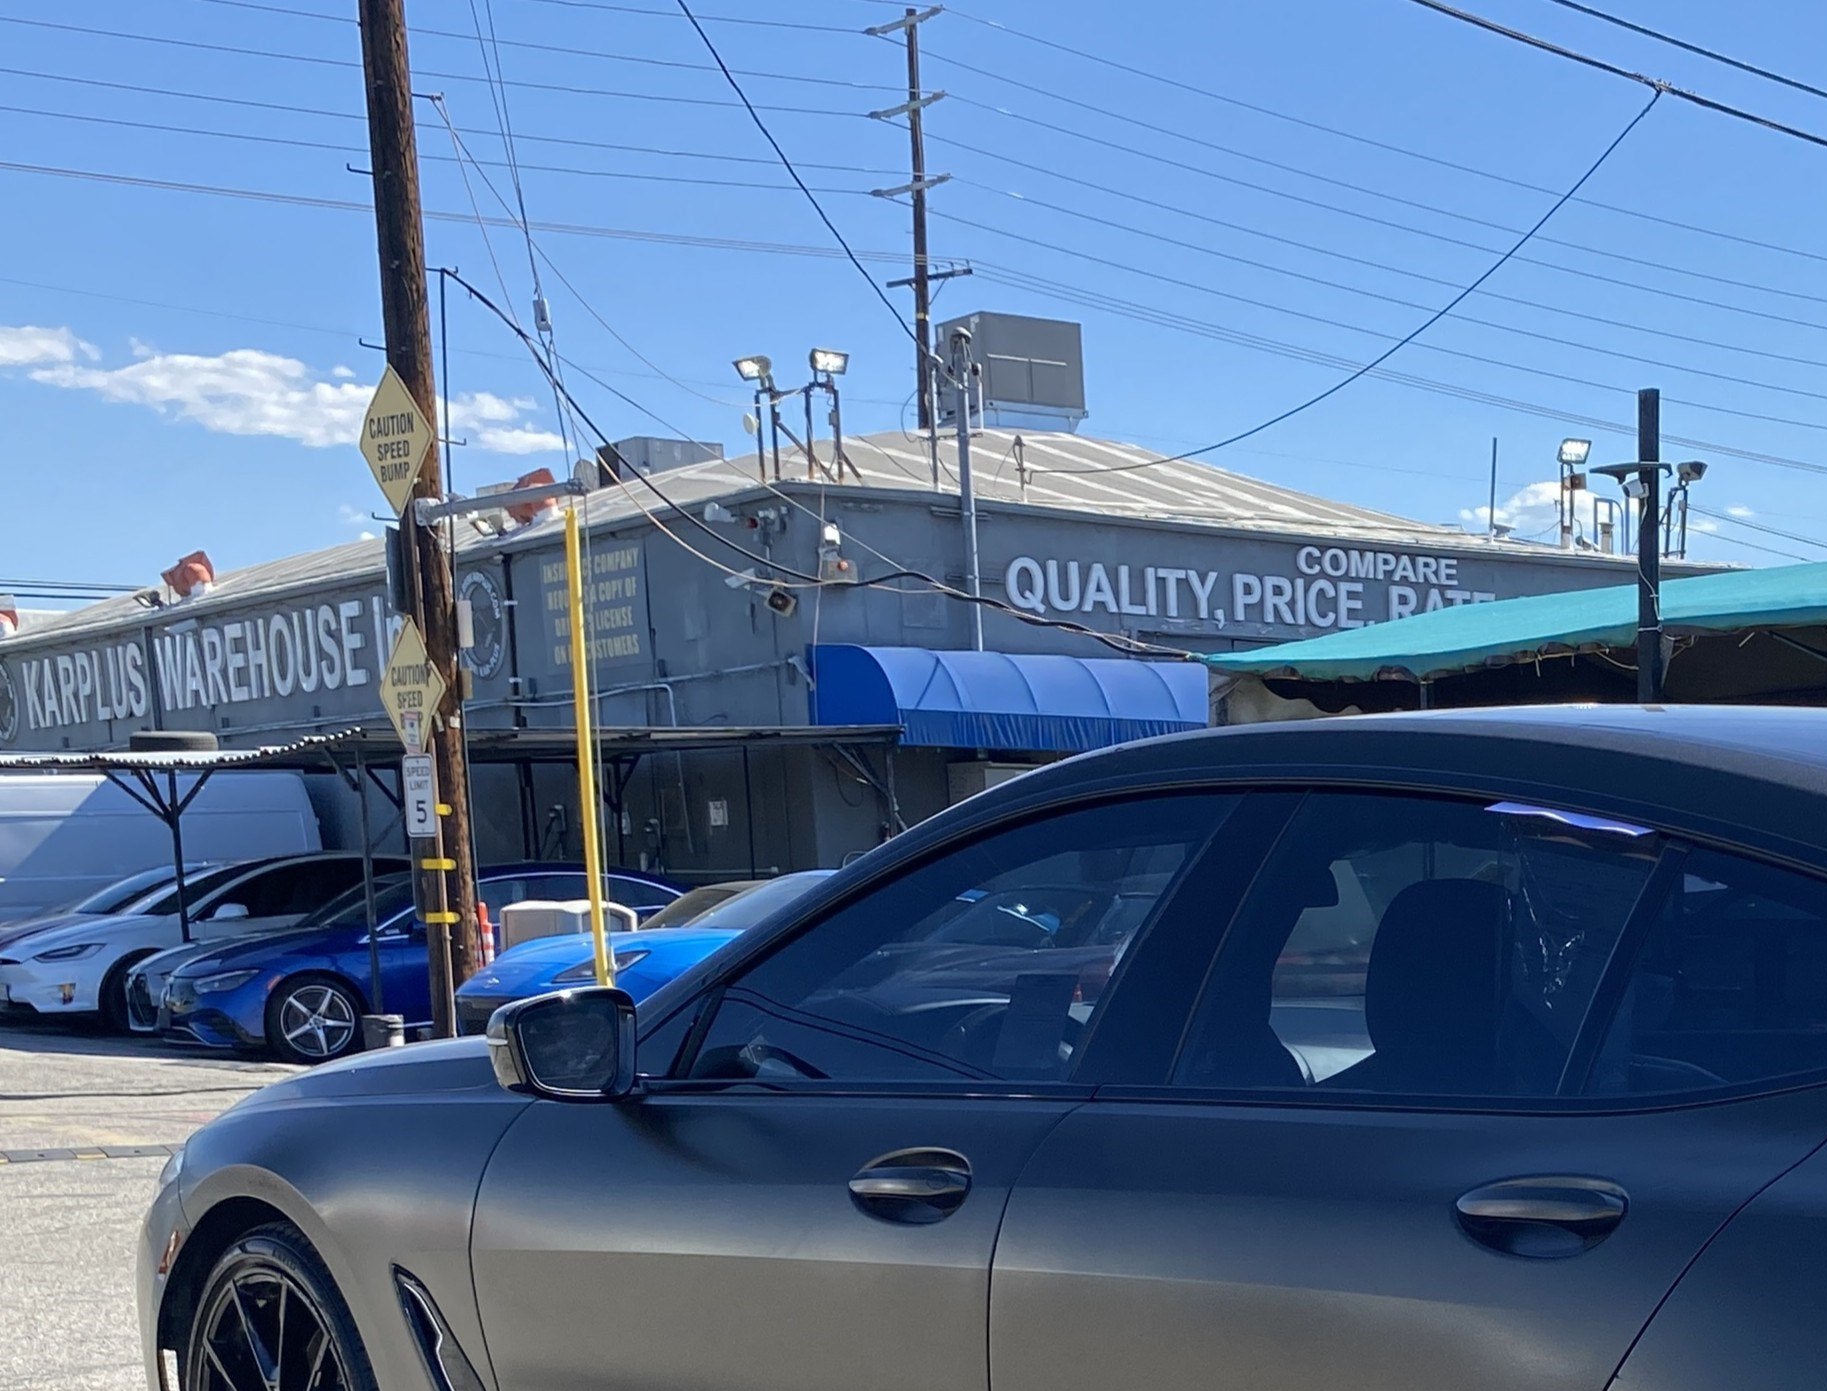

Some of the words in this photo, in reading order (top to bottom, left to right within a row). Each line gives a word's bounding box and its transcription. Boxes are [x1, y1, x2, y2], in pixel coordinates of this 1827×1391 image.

[368, 411, 414, 439] CAUTION
[377, 440, 410, 461] SPEED
[380, 462, 410, 482] BUMP
[594, 547, 639, 574] COMPANY
[1296, 546, 1459, 586] COMPARE
[599, 579, 623, 602] COPY
[625, 576, 636, 597] OF
[1005, 556, 1225, 629] QUALITY,
[595, 606, 634, 631] LICENSE
[22, 642, 150, 730] KARPLUS
[153, 600, 370, 712] WAREHOUSE
[391, 661, 429, 687] CAUTION
[406, 765, 430, 777] SPEED
[409, 779, 429, 791] LIMIT
[416, 800, 427, 823] 5
